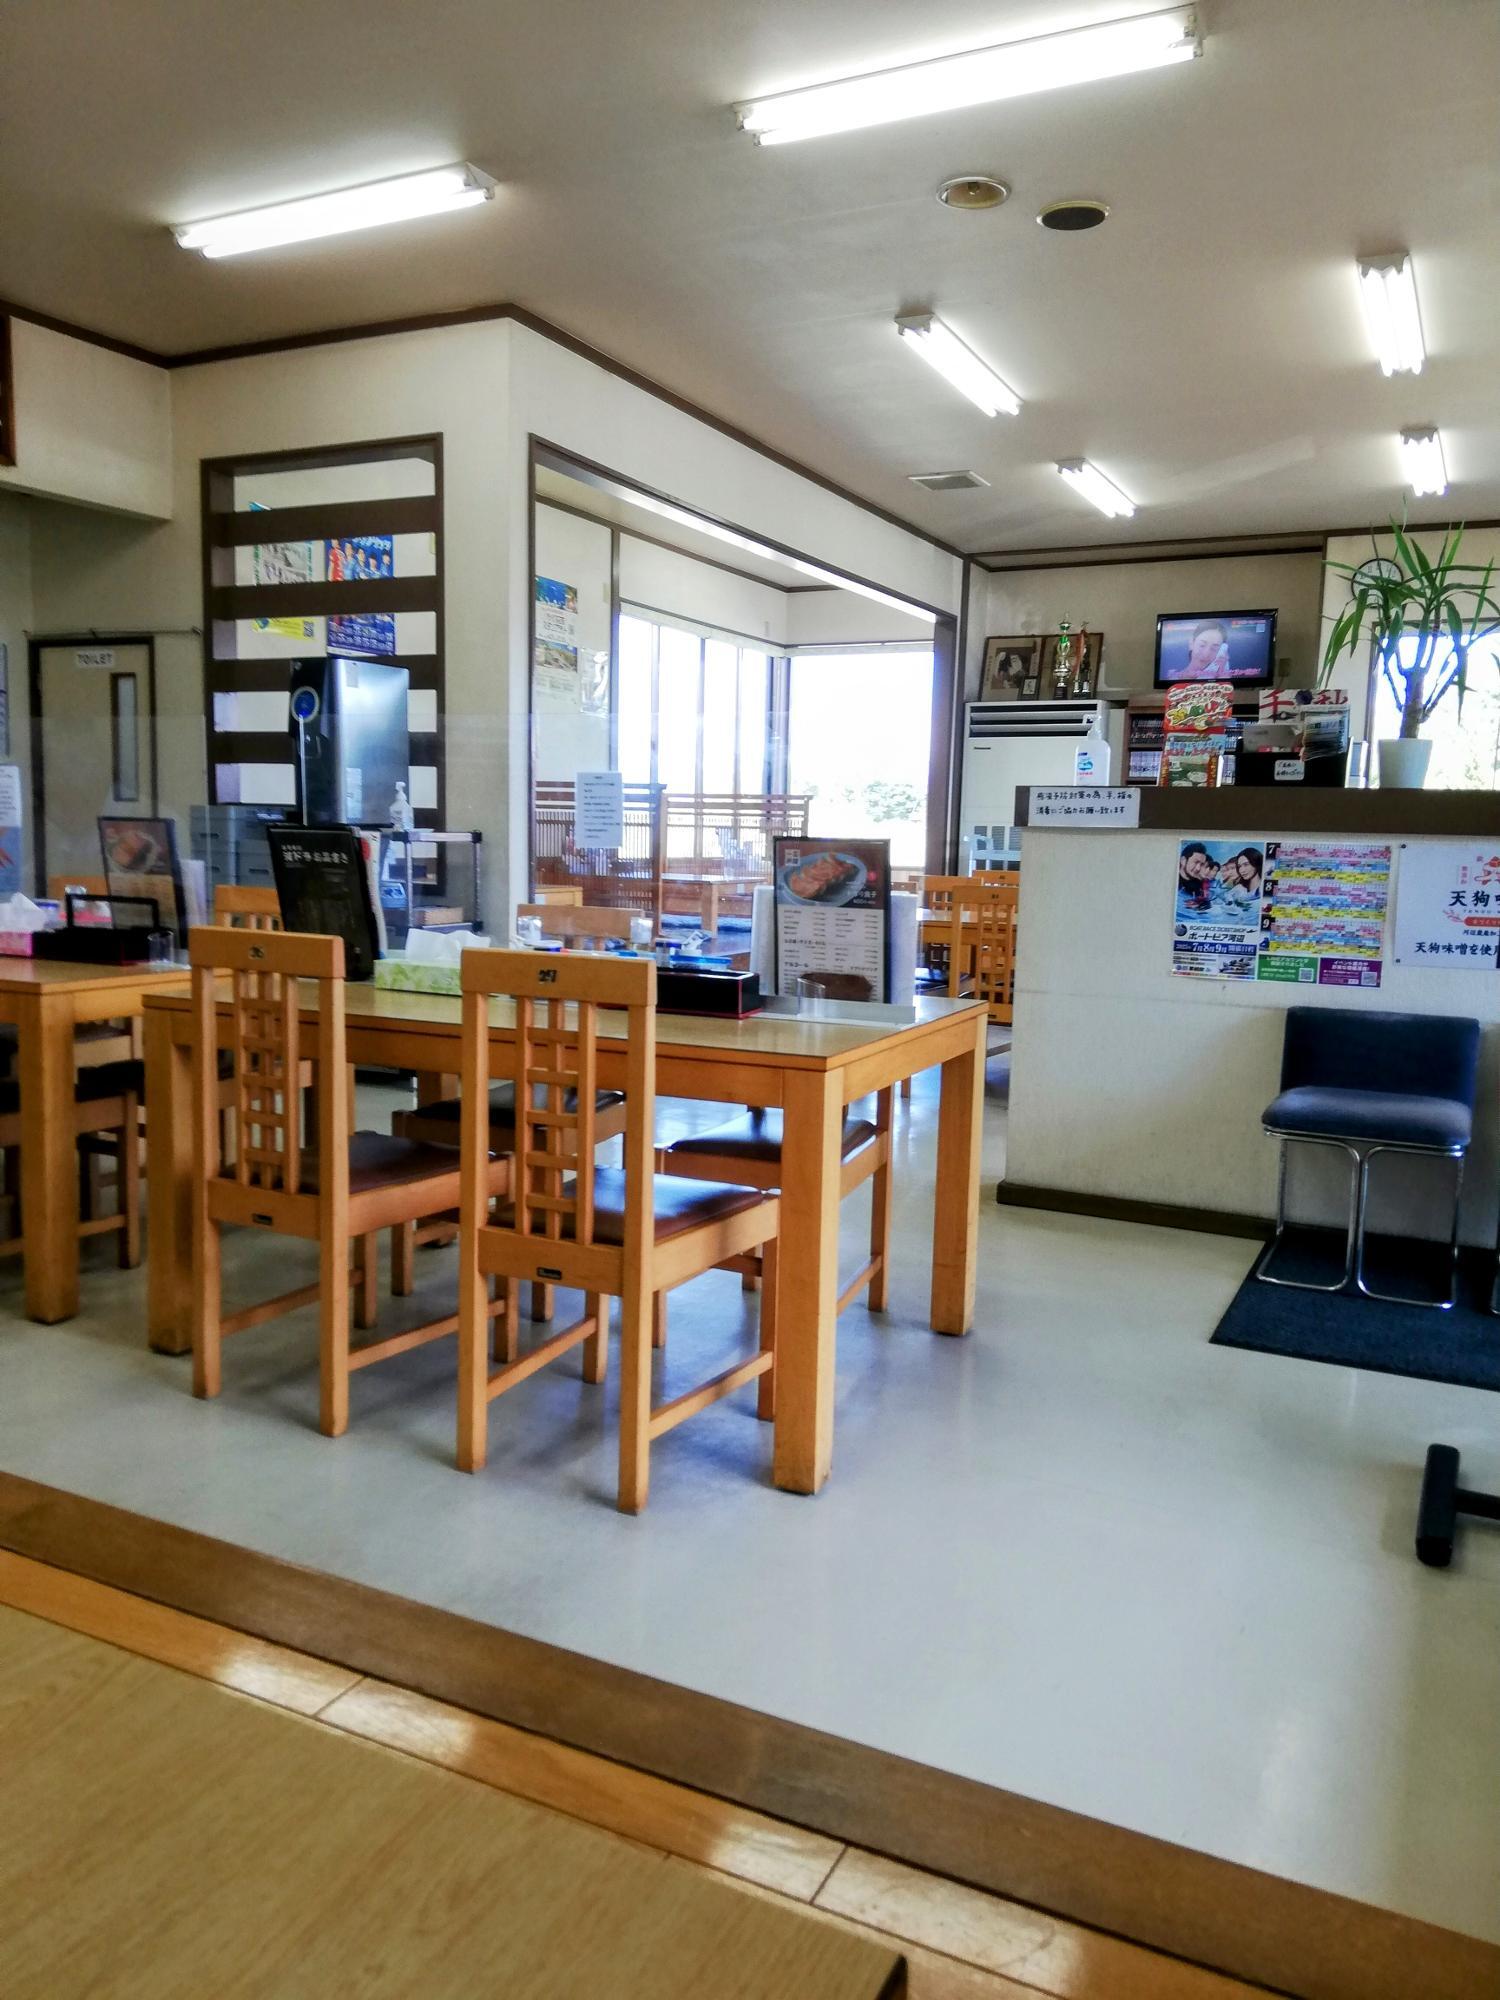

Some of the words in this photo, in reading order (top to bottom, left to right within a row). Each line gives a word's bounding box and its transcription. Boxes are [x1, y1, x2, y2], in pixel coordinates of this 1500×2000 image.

[77, 653, 112, 665] TOILET
[1268, 844, 1276, 855] 7
[1265, 882, 1273, 891] 8
[1262, 918, 1270, 928] 9
